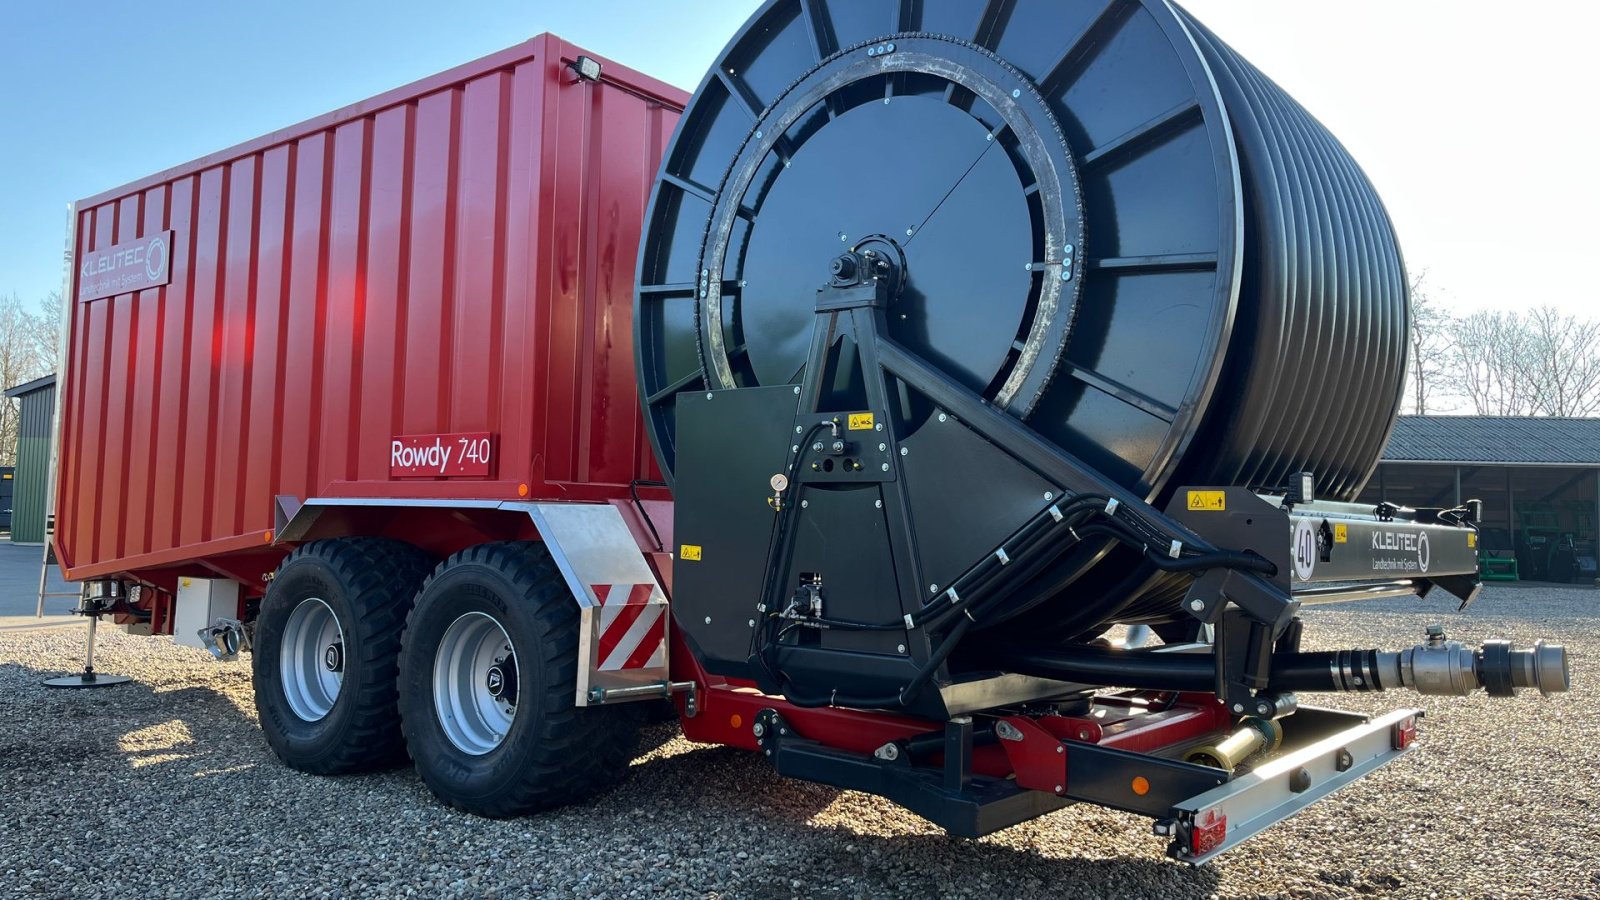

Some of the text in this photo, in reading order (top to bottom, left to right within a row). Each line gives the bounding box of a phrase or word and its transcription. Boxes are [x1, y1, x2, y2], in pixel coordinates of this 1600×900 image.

[81, 246, 144, 278] KLEUTEC
[121, 273, 143, 288] System
[391, 437, 491, 473] Rowdy 740
[1297, 529, 1312, 569] 40
[1372, 530, 1417, 552] KLEUTEC
